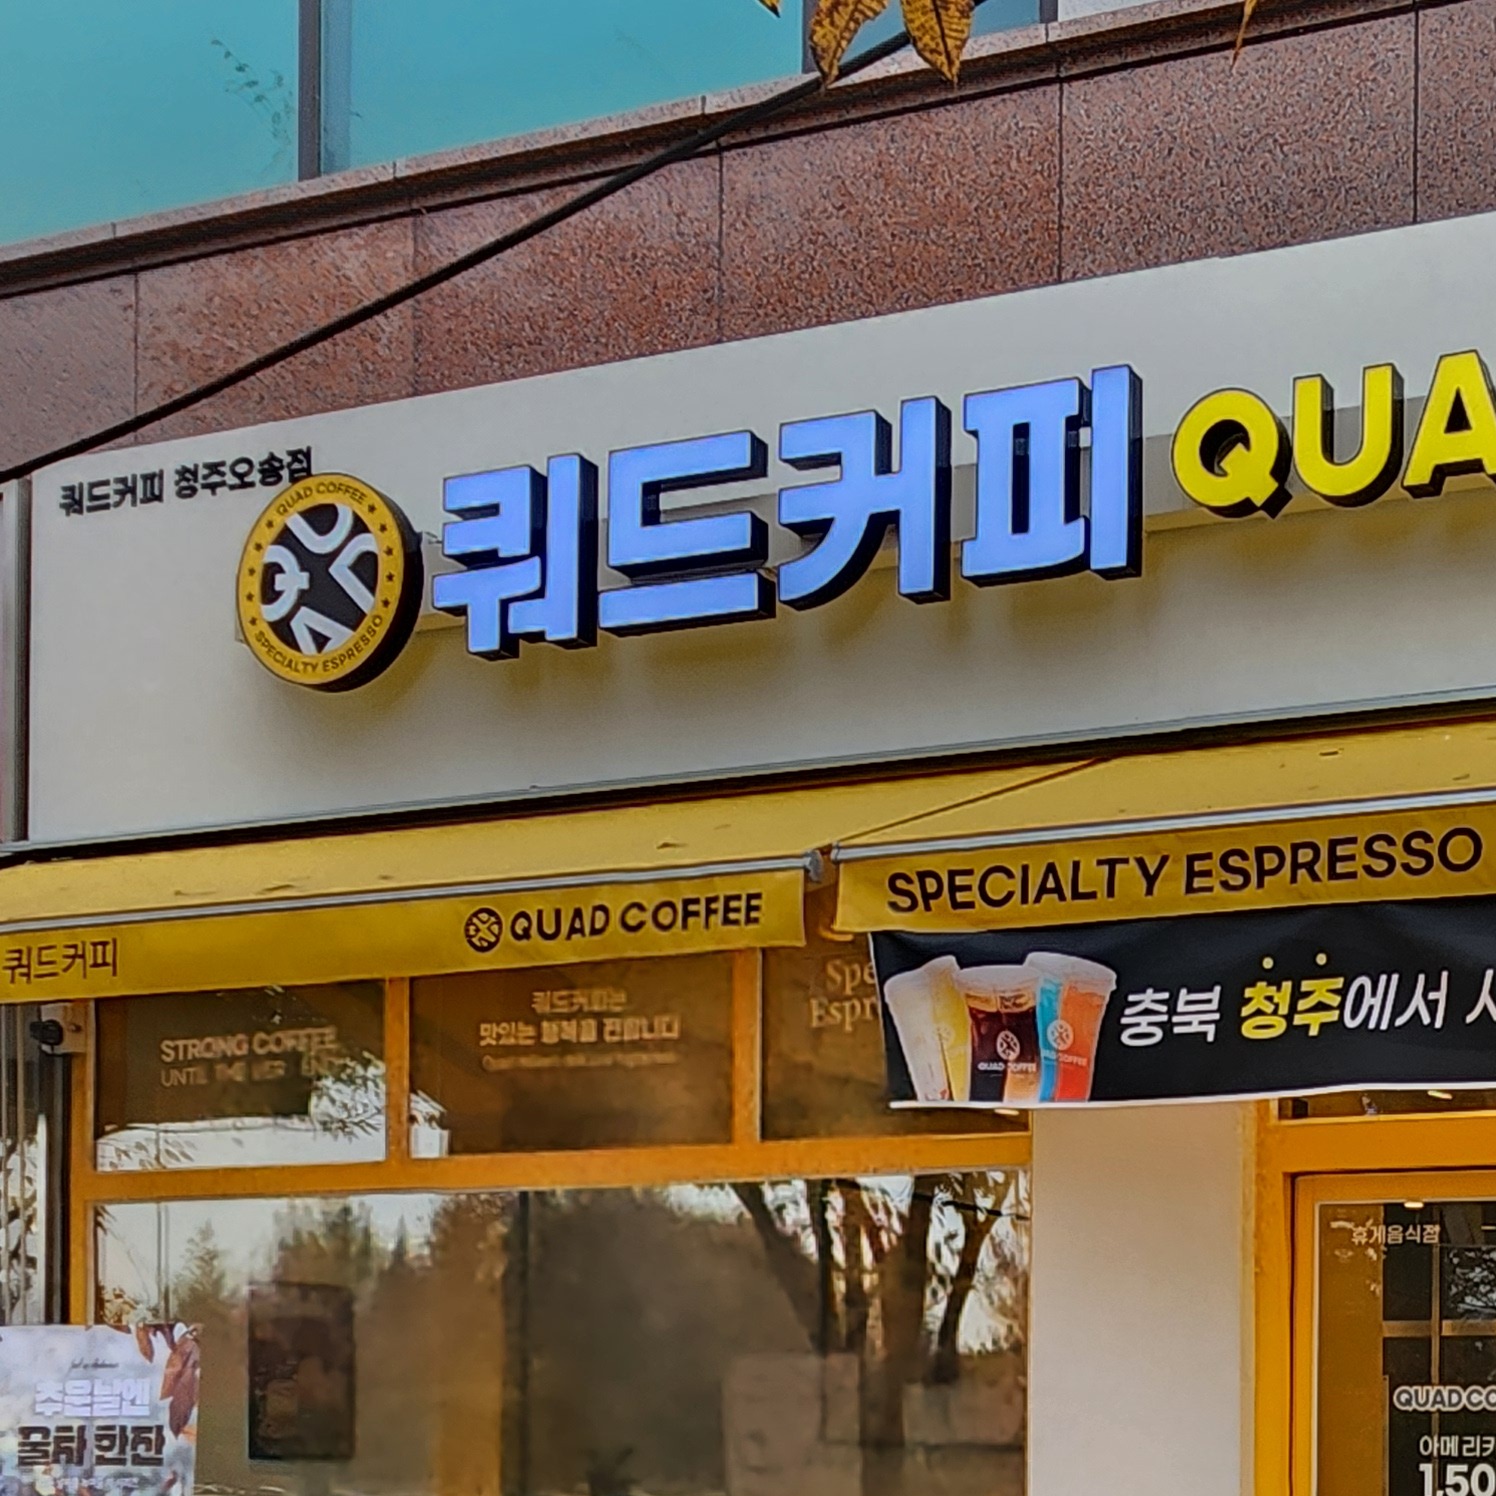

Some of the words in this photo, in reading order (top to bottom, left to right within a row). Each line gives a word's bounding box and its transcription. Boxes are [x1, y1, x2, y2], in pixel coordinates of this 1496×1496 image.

[59, 469, 164, 517] 쿼드커피
[174, 446, 312, 500] 청주오송점
[276, 485, 313, 516] QUAD
[316, 482, 367, 505] COFFEE
[432, 364, 1142, 660] 쿼드커피
[254, 630, 319, 674] SPECIALTY
[322, 614, 383, 672] ESPRESSO
[887, 853, 1170, 914] SPECIALTY
[1184, 826, 1484, 896] ESPRESSO
[510, 903, 611, 942] QUAD
[619, 892, 763, 933] COFFEE
[1, 937, 117, 985] 쿼드커피
[1119, 985, 1222, 1048] 충북
[1239, 969, 1451, 1041] 청주에서
[160, 1033, 249, 1062] STRONG
[479, 1021, 537, 1047] 맛있는
[1351, 1223, 1441, 1246] 휴게음식점
[1394, 1385, 1465, 1411] QUAD
[94, 1425, 166, 1467] 한잔
